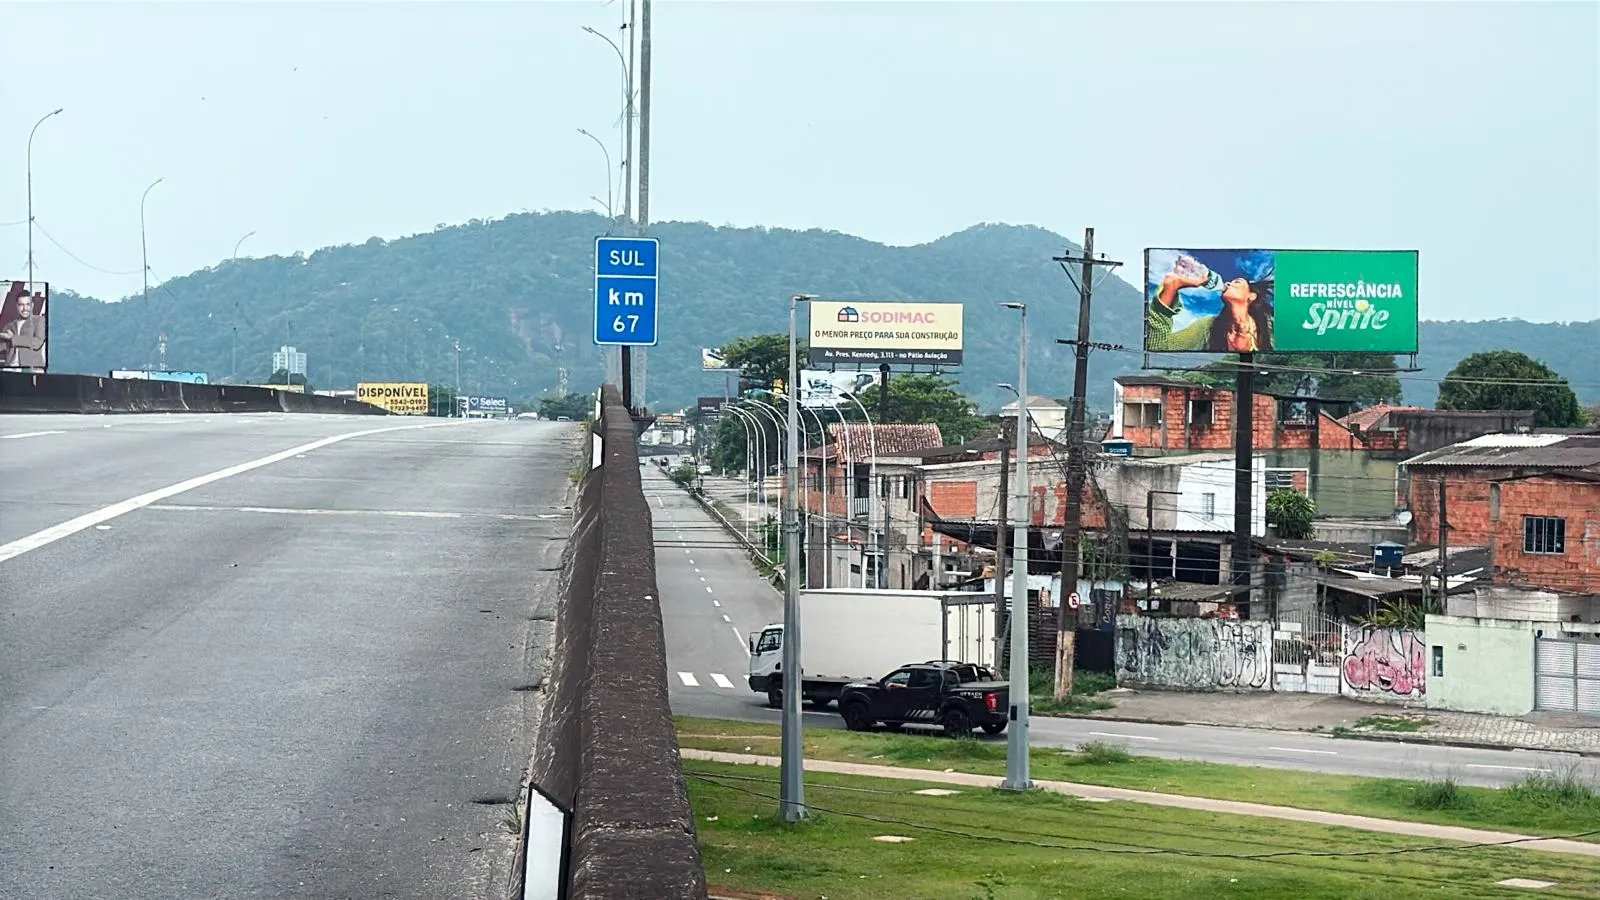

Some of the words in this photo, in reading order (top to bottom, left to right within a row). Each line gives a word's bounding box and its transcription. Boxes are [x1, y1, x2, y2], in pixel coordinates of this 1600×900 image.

[610, 250, 645, 266] SUL
[1290, 280, 1402, 298] REFRESCÂNCIA
[608, 288, 644, 306] km
[1326, 298, 1354, 309] NÍVEL
[613, 315, 639, 333] 67
[861, 311, 936, 324] SODIMAC
[1302, 300, 1390, 335] Sprite
[815, 330, 820, 338] O
[822, 330, 849, 338] MENOR
[850, 331, 873, 340] PREÇO
[874, 331, 894, 339] PARA
[911, 330, 958, 341] CONSTRUÇÃO
[358, 385, 427, 398] DISPONÍVEL
[480, 397, 506, 407] Select
